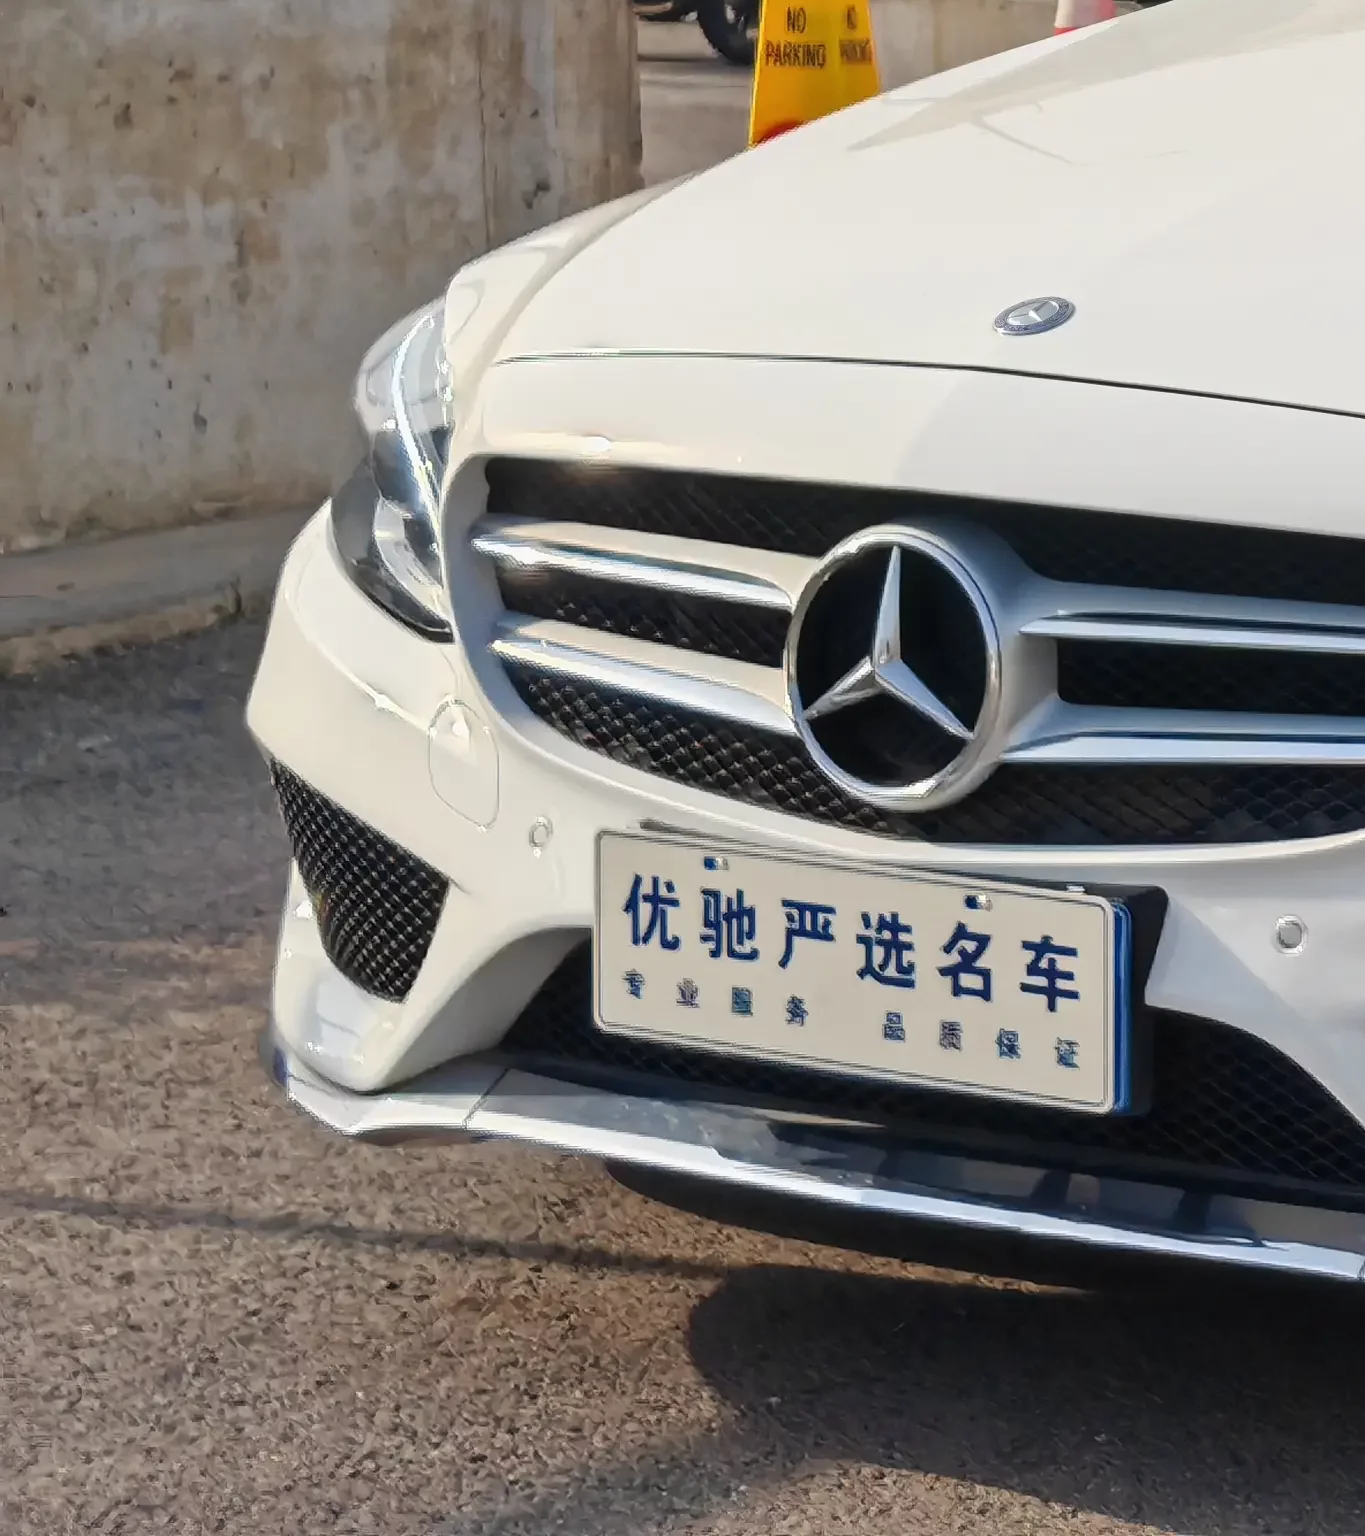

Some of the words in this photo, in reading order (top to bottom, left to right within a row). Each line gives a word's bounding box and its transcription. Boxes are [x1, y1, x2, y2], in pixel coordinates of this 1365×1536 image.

[787, 6, 807, 34] NO
[623, 873, 1081, 1013] 优驰严选名车
